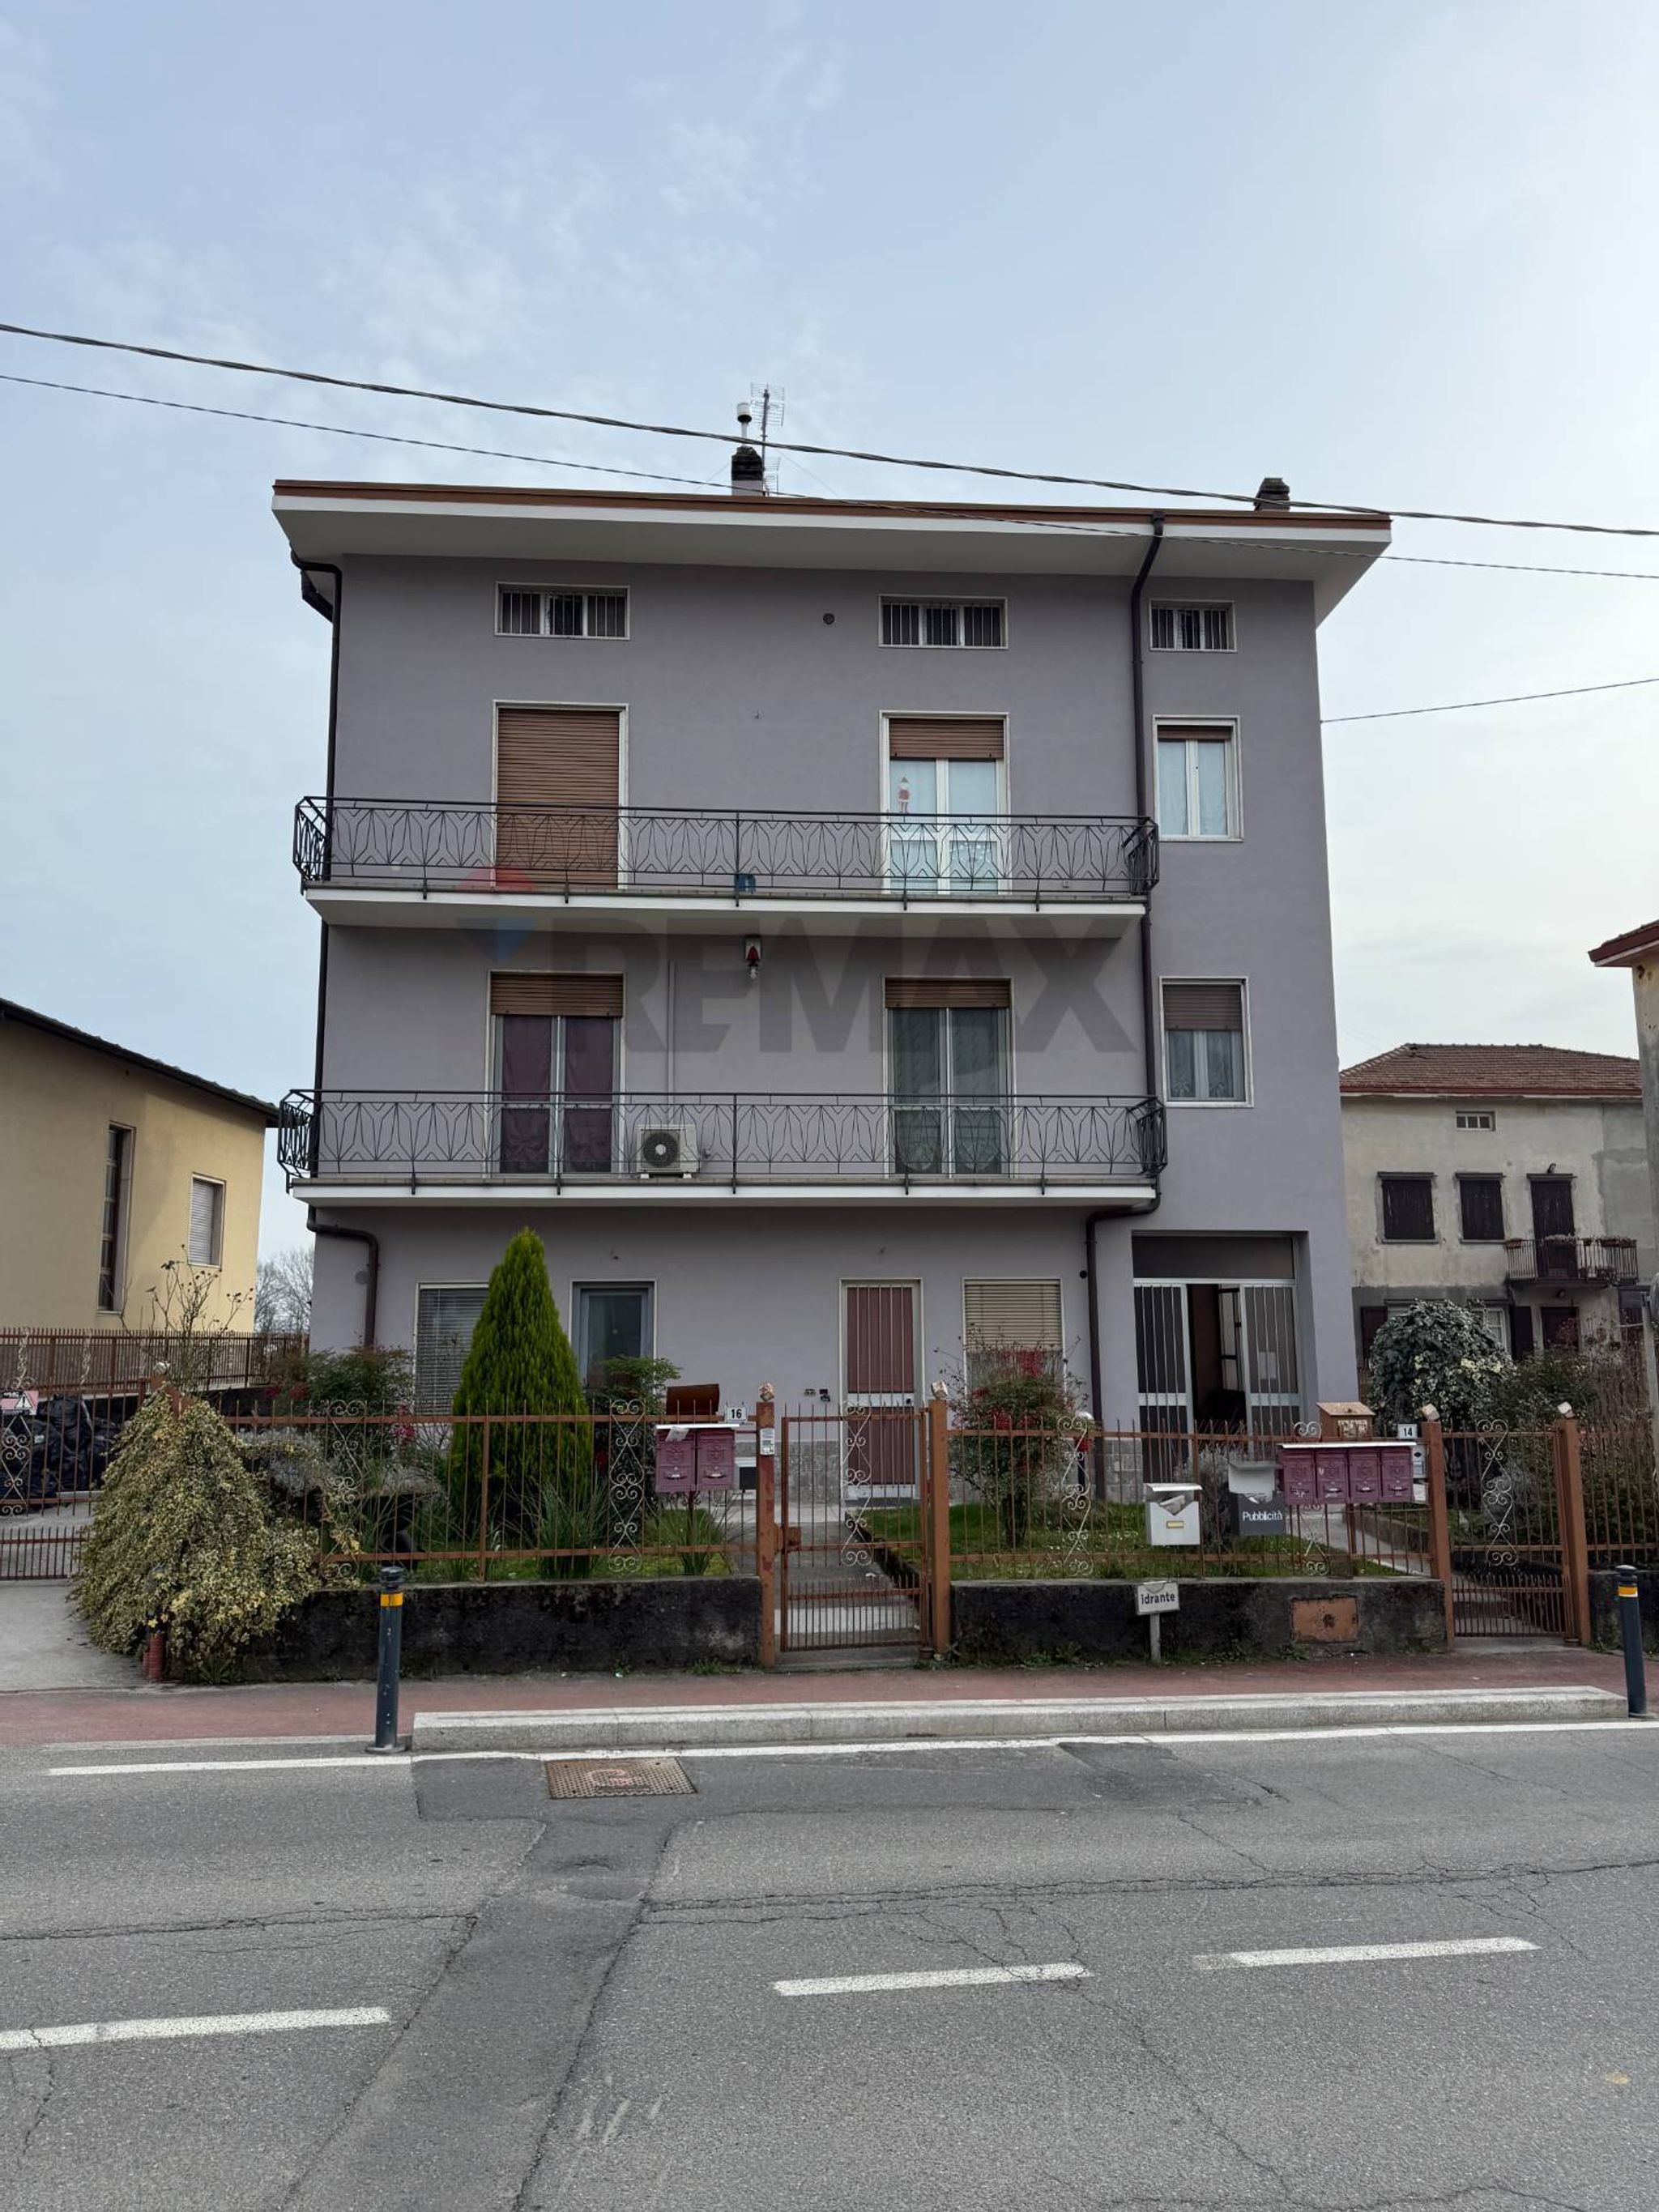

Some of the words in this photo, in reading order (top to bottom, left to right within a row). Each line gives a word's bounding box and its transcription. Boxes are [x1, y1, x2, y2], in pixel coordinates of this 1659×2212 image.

[731, 1409, 742, 1419] 16
[1404, 1427, 1413, 1437] 14
[1242, 1510, 1283, 1522] Pubblicità
